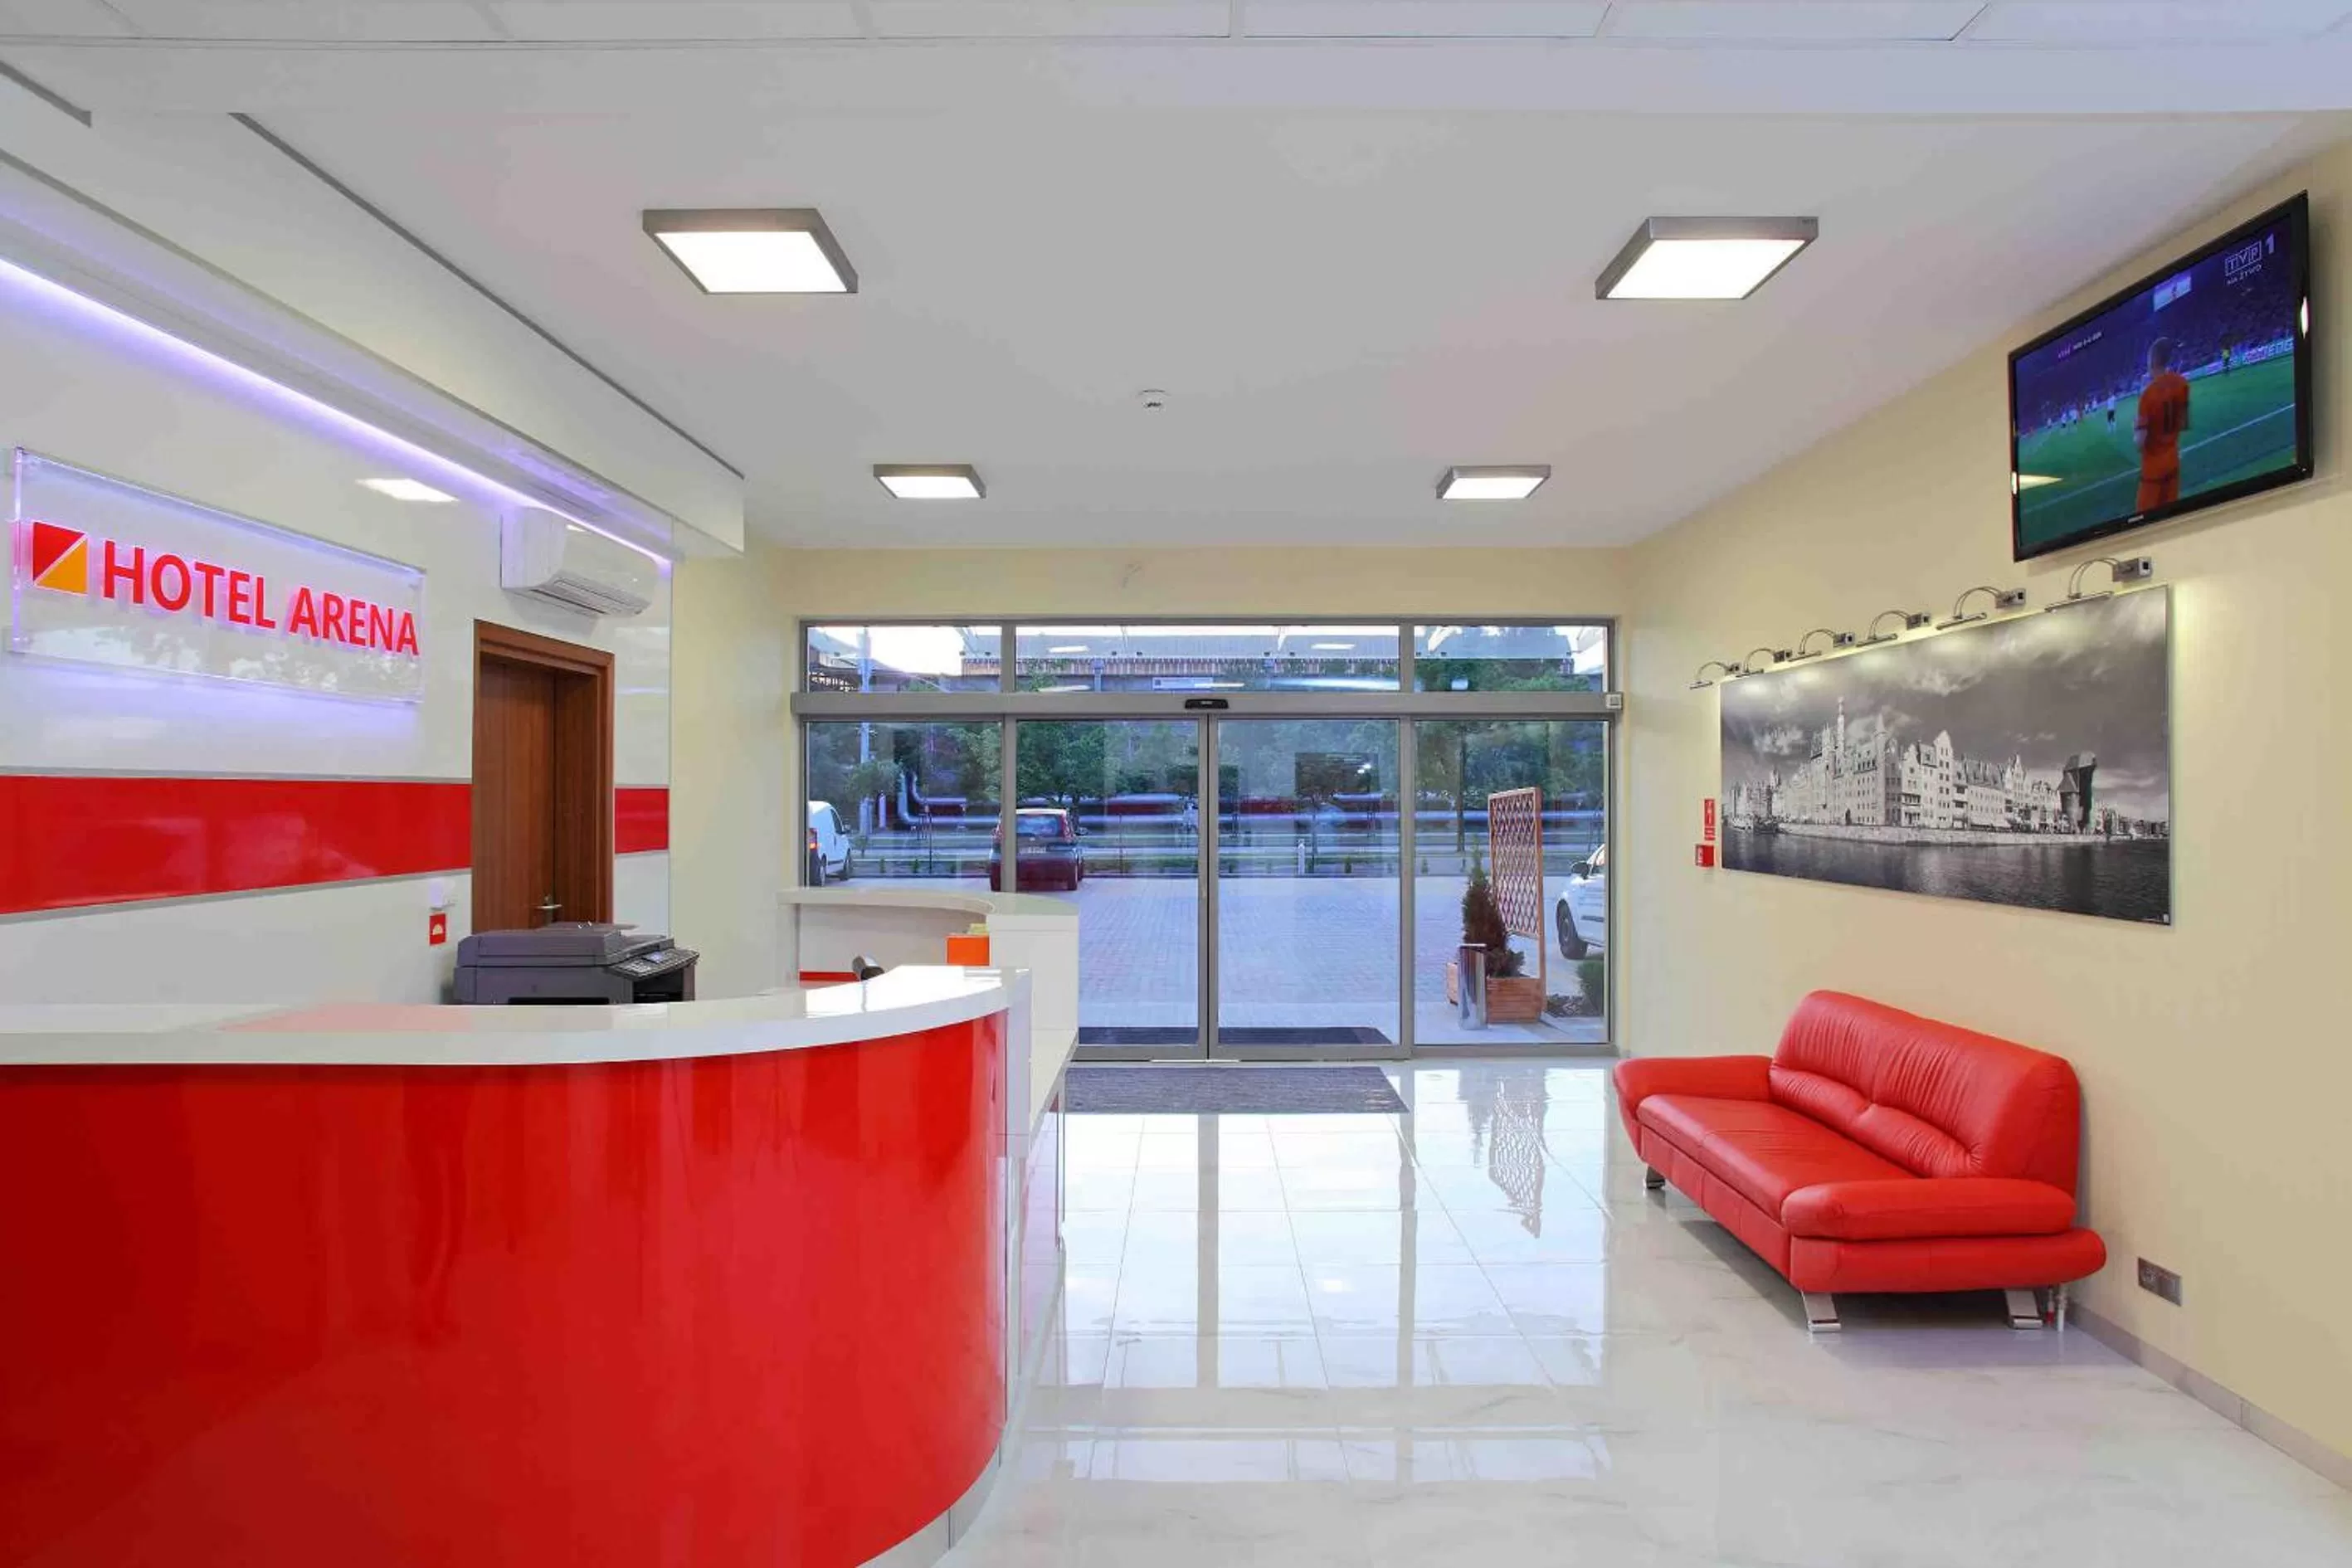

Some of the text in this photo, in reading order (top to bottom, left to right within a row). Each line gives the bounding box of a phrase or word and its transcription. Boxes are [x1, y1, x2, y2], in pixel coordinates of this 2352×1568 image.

[2226, 233, 2274, 273] TVP 1
[104, 540, 419, 656] HOTEL ARENA
